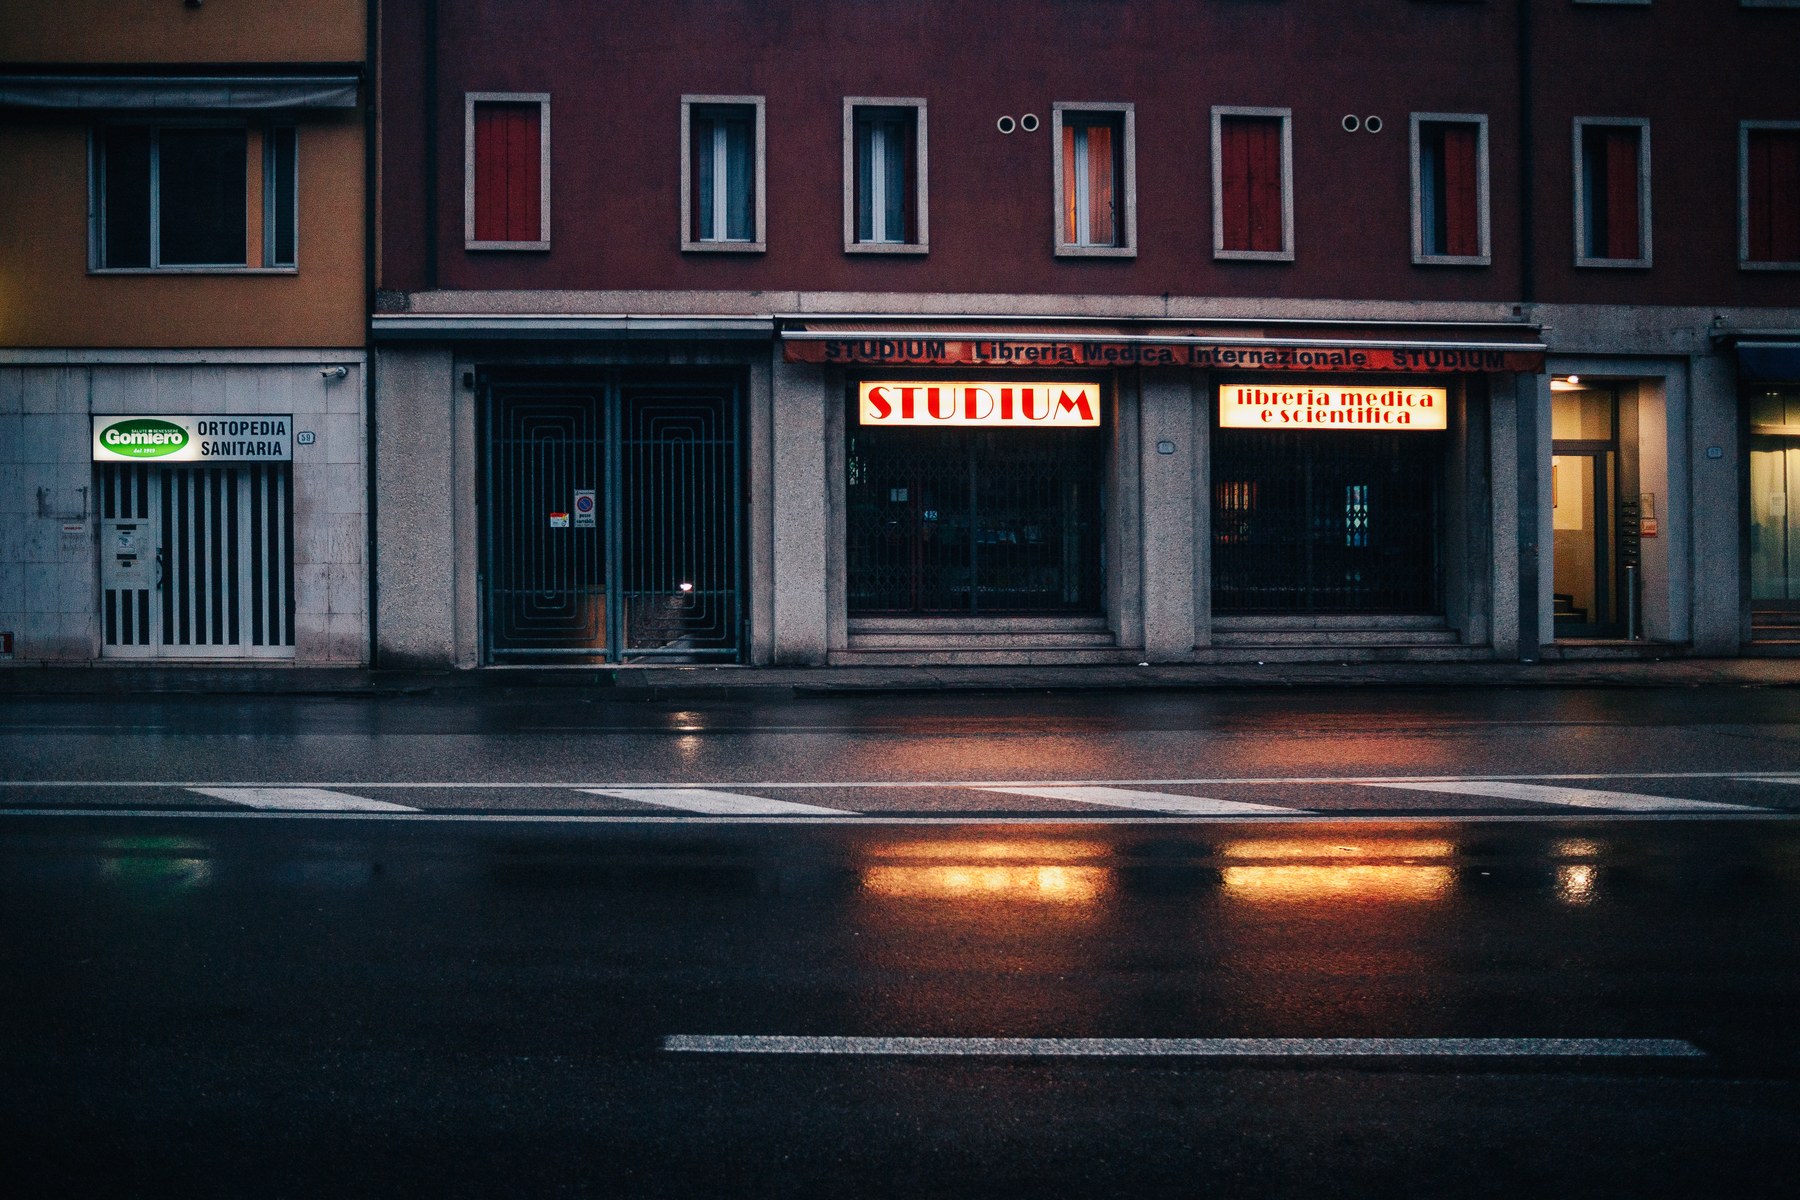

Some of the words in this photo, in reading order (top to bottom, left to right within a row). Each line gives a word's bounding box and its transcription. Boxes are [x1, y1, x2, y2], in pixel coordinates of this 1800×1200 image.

[824, 340, 946, 361] STUDIUM
[972, 342, 1075, 362] Libreria
[1083, 343, 1172, 362] Medica
[1188, 346, 1367, 368] Internazionale
[1392, 350, 1506, 370] STUDIUM
[868, 386, 1094, 421] STUDIUM
[1237, 388, 1330, 407] libreria
[1340, 390, 1434, 408] medica
[1260, 408, 1272, 423] e
[1279, 406, 1411, 425] scientifica
[105, 428, 183, 446] Gomiero
[197, 420, 286, 437] ORTOPEDIA
[201, 440, 283, 457] SANITARIA
